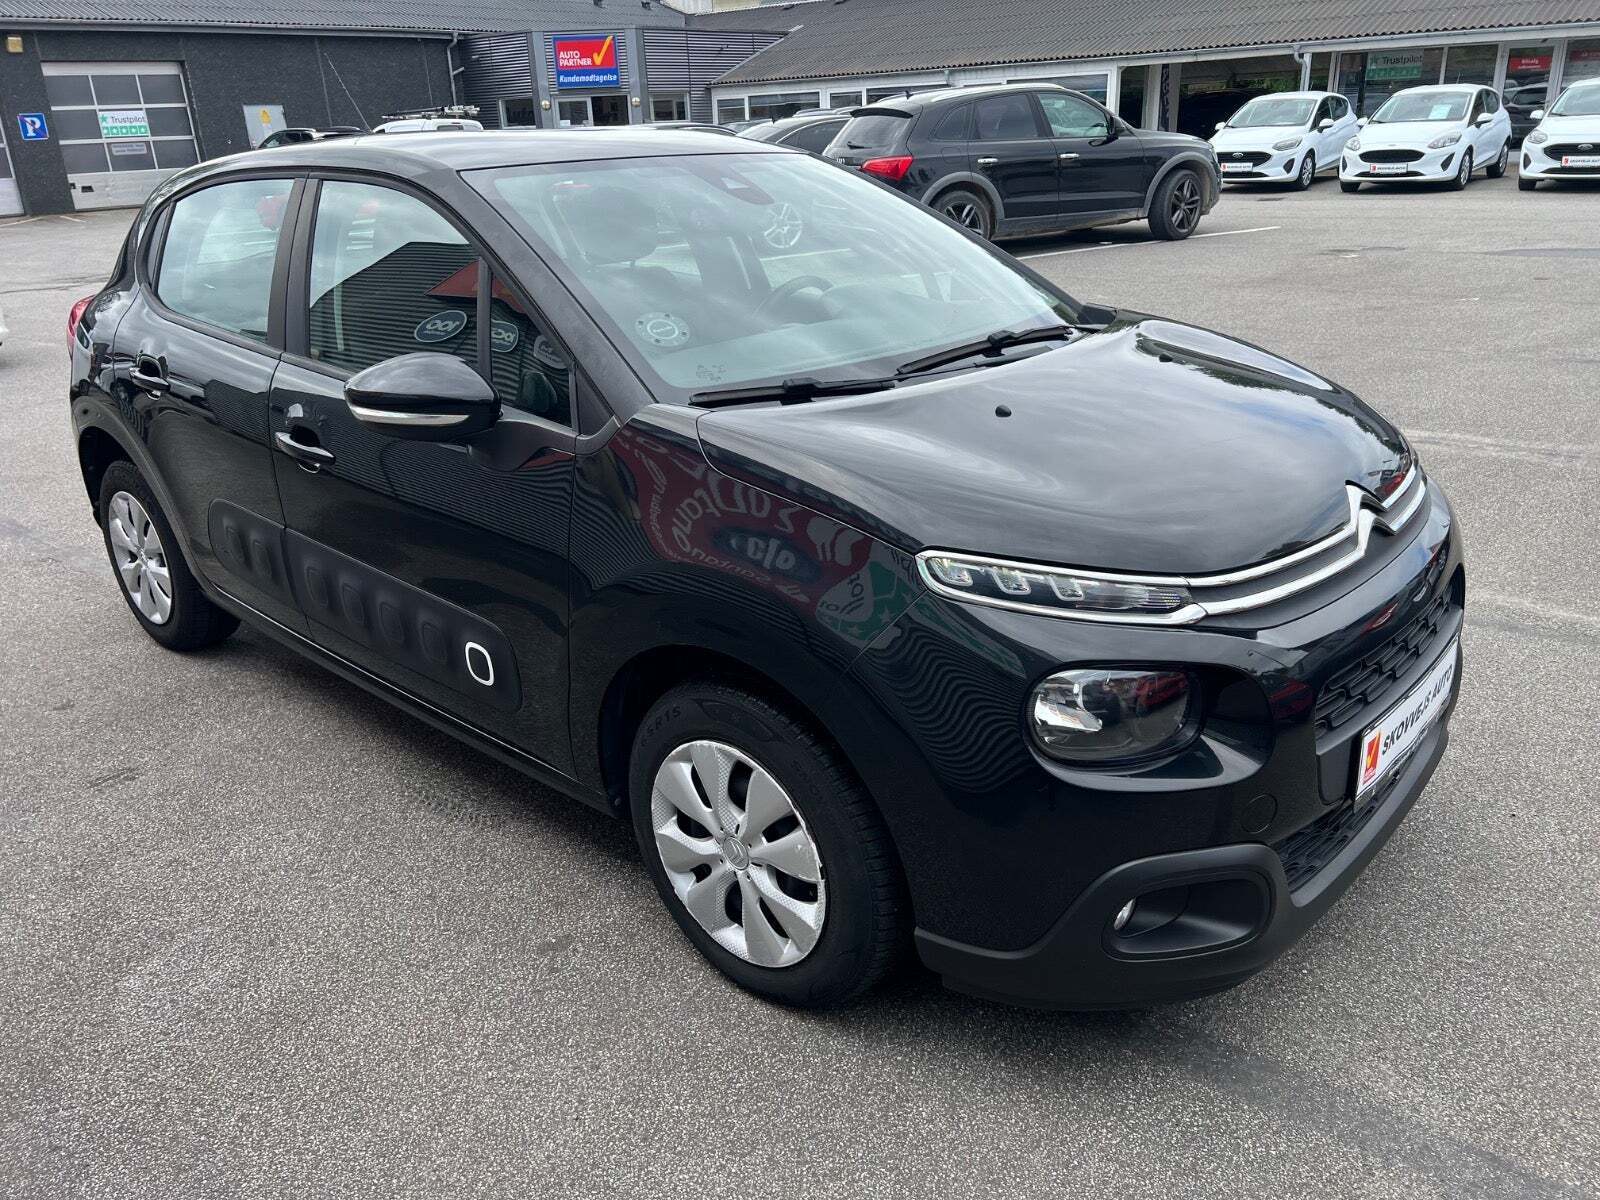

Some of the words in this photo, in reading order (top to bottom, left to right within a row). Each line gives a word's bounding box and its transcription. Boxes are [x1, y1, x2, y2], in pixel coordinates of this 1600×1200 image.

[559, 50, 580, 59] AUTO
[559, 58, 593, 67] PARTNER
[1382, 55, 1423, 65] Trustpilot
[559, 74, 618, 83] Kundemodtagelse
[111, 115, 146, 124] Trustpilot
[24, 117, 41, 137] P
[1382, 690, 1432, 756] SKOVVEJS
[1431, 663, 1453, 703] AUTO
